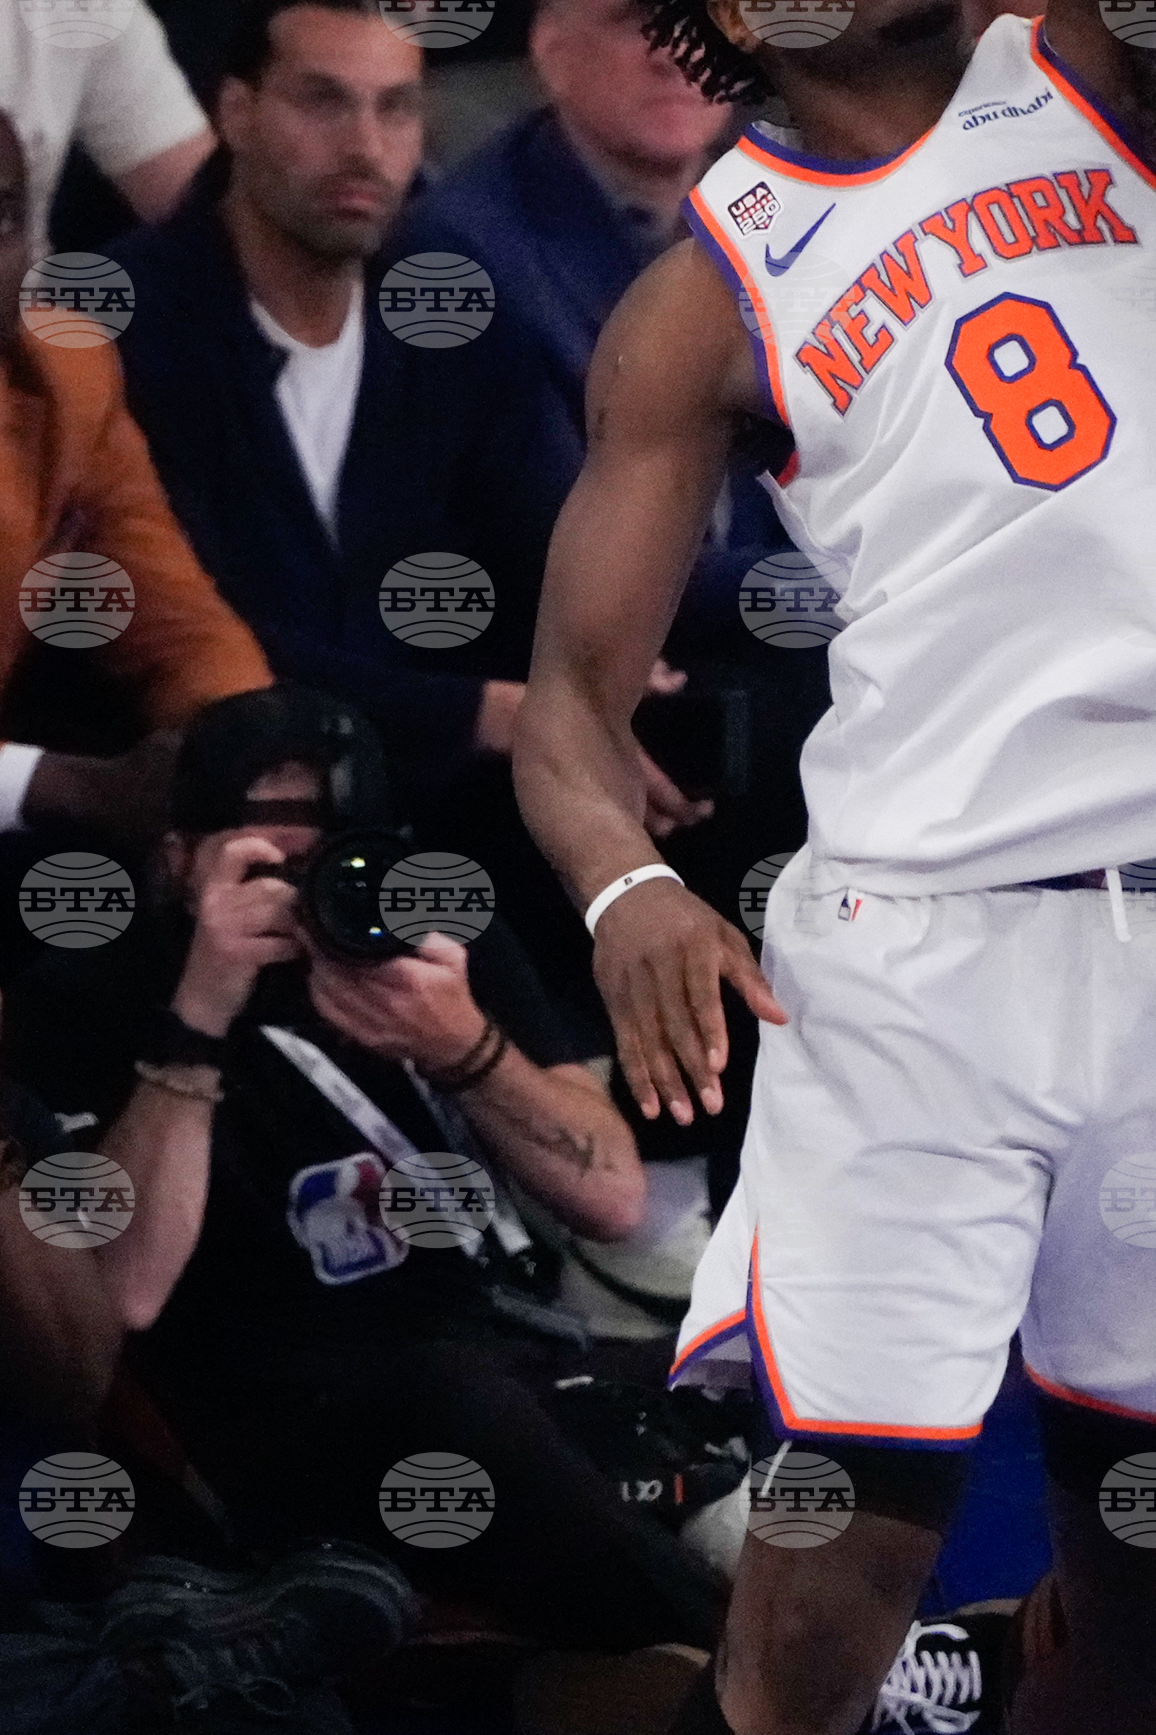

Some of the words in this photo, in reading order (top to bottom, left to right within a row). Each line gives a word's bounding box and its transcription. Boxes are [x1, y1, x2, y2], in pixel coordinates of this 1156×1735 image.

[962, 110, 999, 131] abu
[1001, 87, 1053, 118] dhabi
[730, 186, 769, 216] USA
[739, 199, 780, 235] 250
[795, 229, 934, 417] NEW
[919, 166, 1144, 282] YORK
[944, 291, 1118, 493] 8
